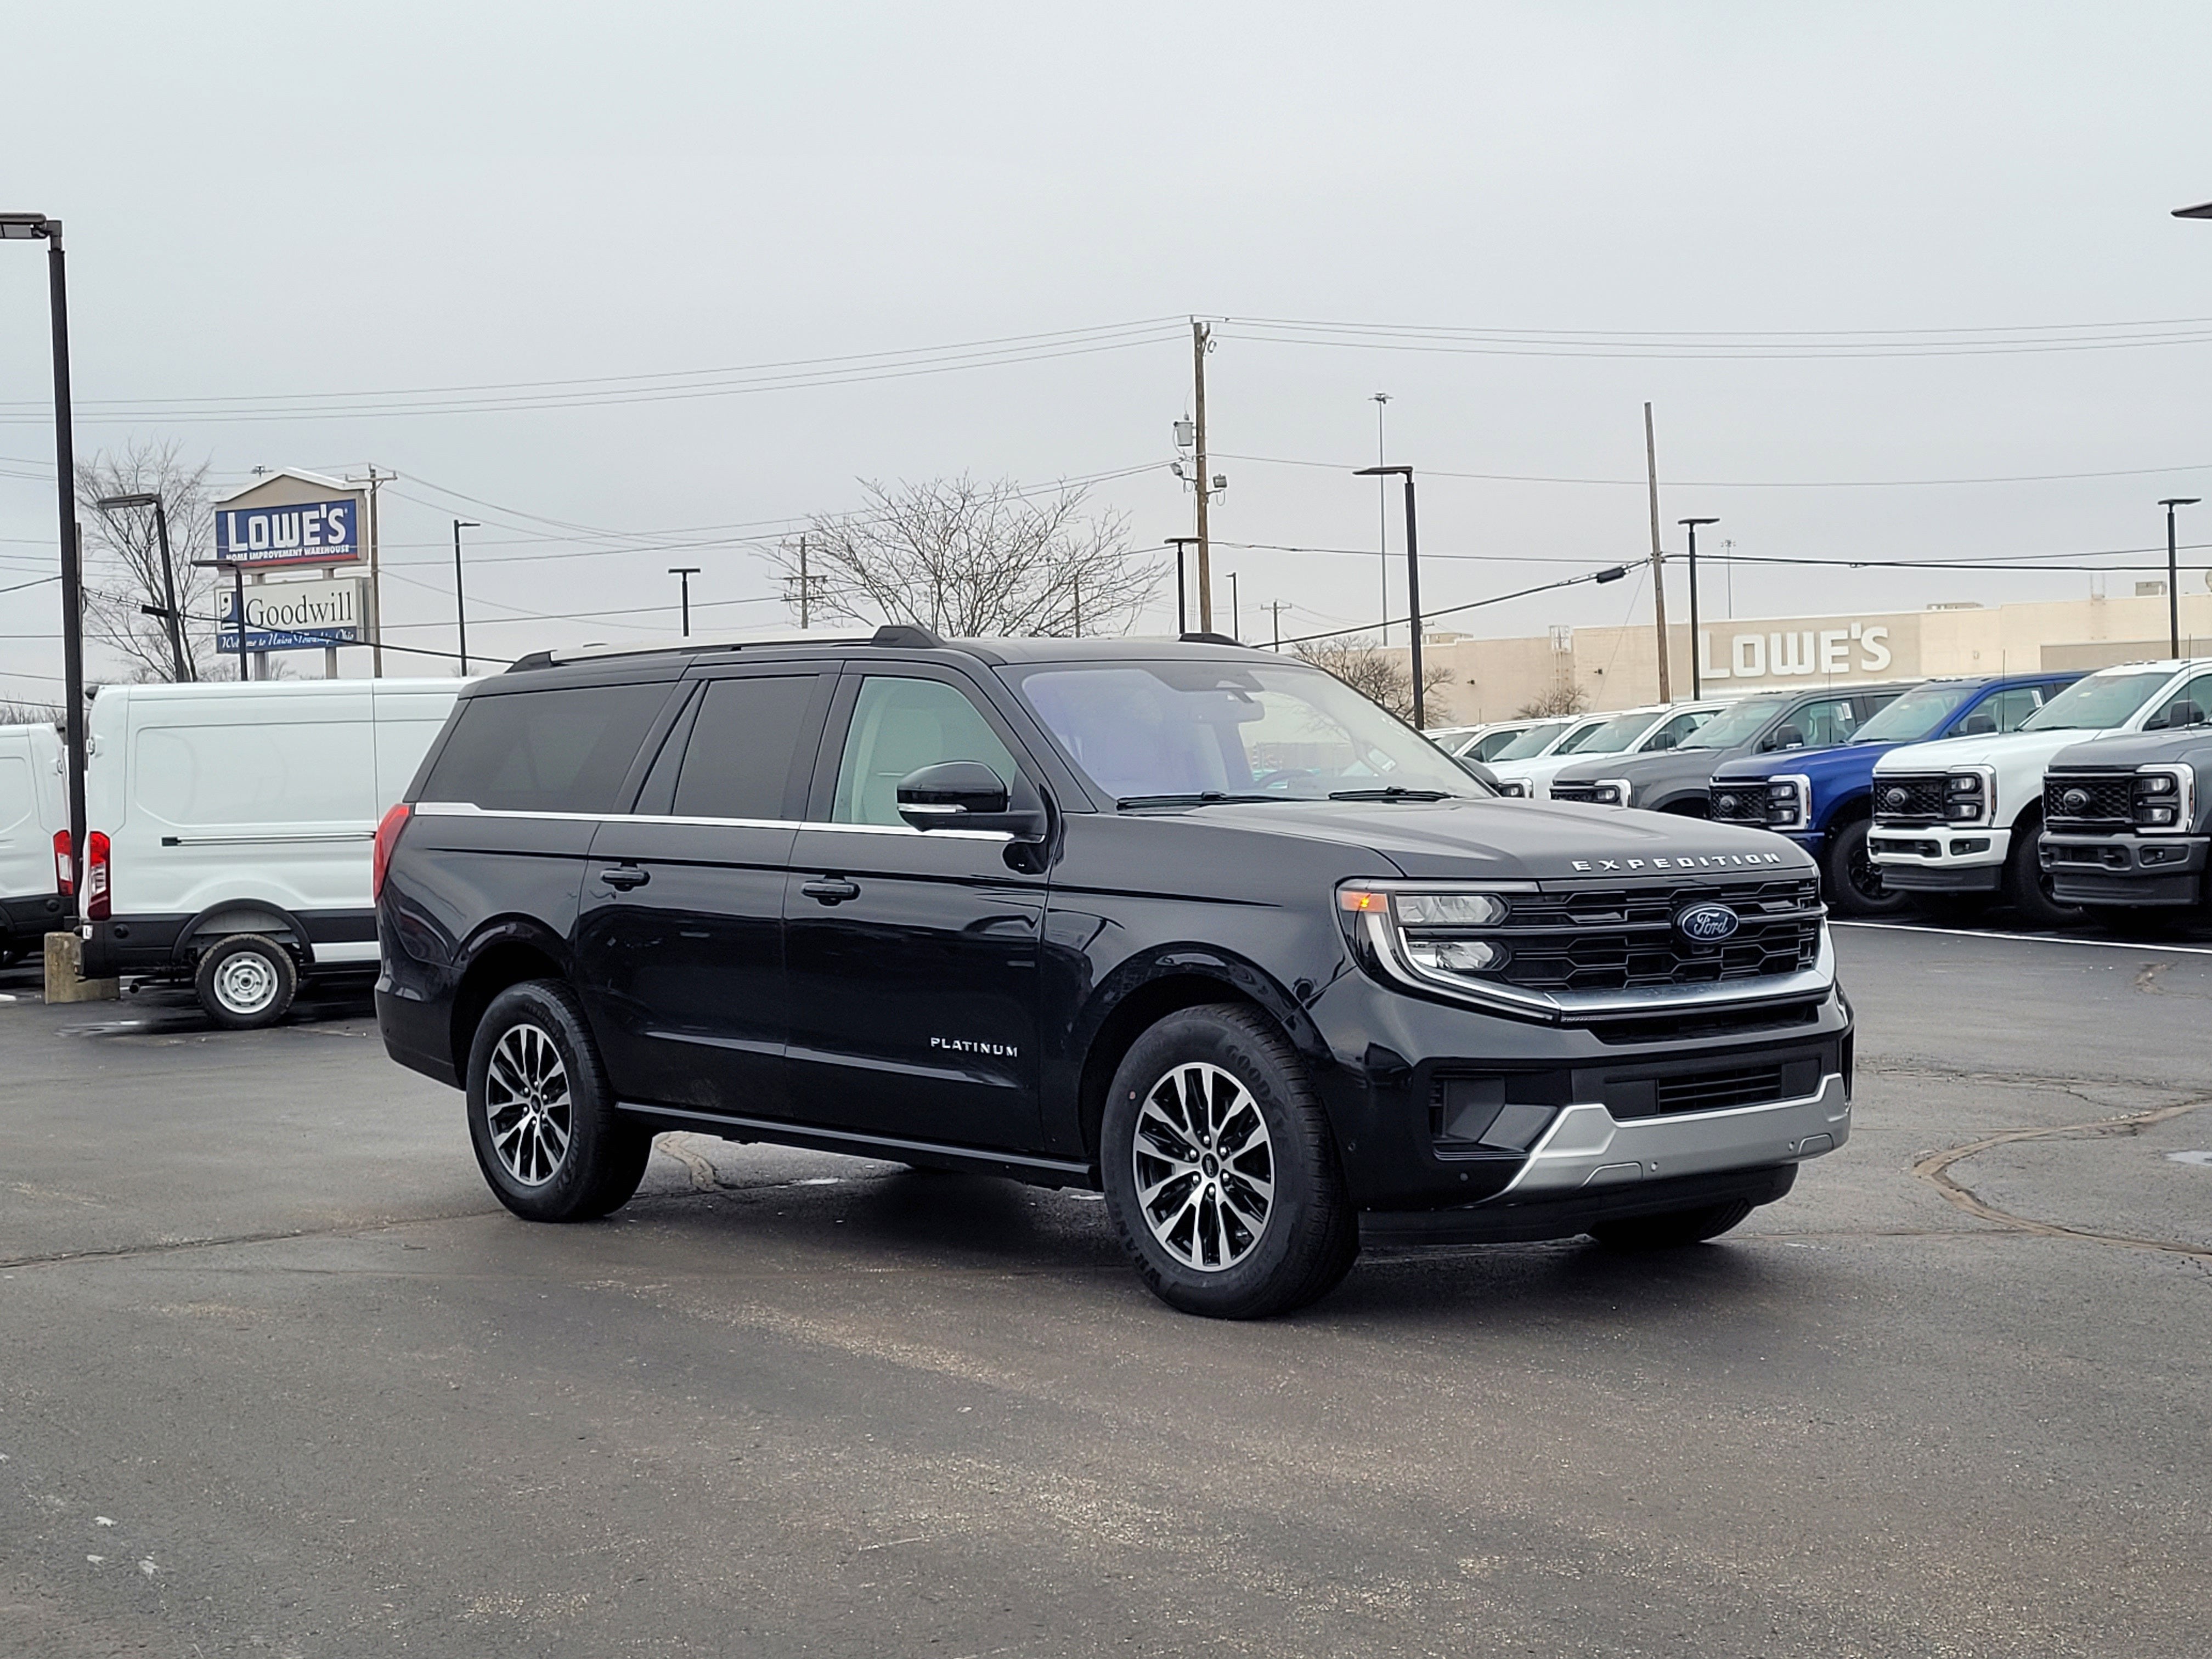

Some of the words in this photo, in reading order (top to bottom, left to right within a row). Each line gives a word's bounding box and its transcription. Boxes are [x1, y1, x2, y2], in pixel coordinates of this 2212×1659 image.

[227, 504, 348, 552] LOWE'S
[225, 552, 248, 561] HOME
[249, 548, 303, 560] IMPROVEMENT
[303, 544, 350, 556] WAREHOUSE
[246, 591, 352, 627] Goodwill
[222, 636, 257, 648] Welme
[268, 633, 292, 646] Union
[336, 628, 354, 641] Ohio
[1700, 622, 1892, 679] LOWE'S
[1572, 853, 1781, 871] EXPEDITION
[1694, 912, 1728, 935] Ford
[930, 1037, 1018, 1058] PLATINUM
